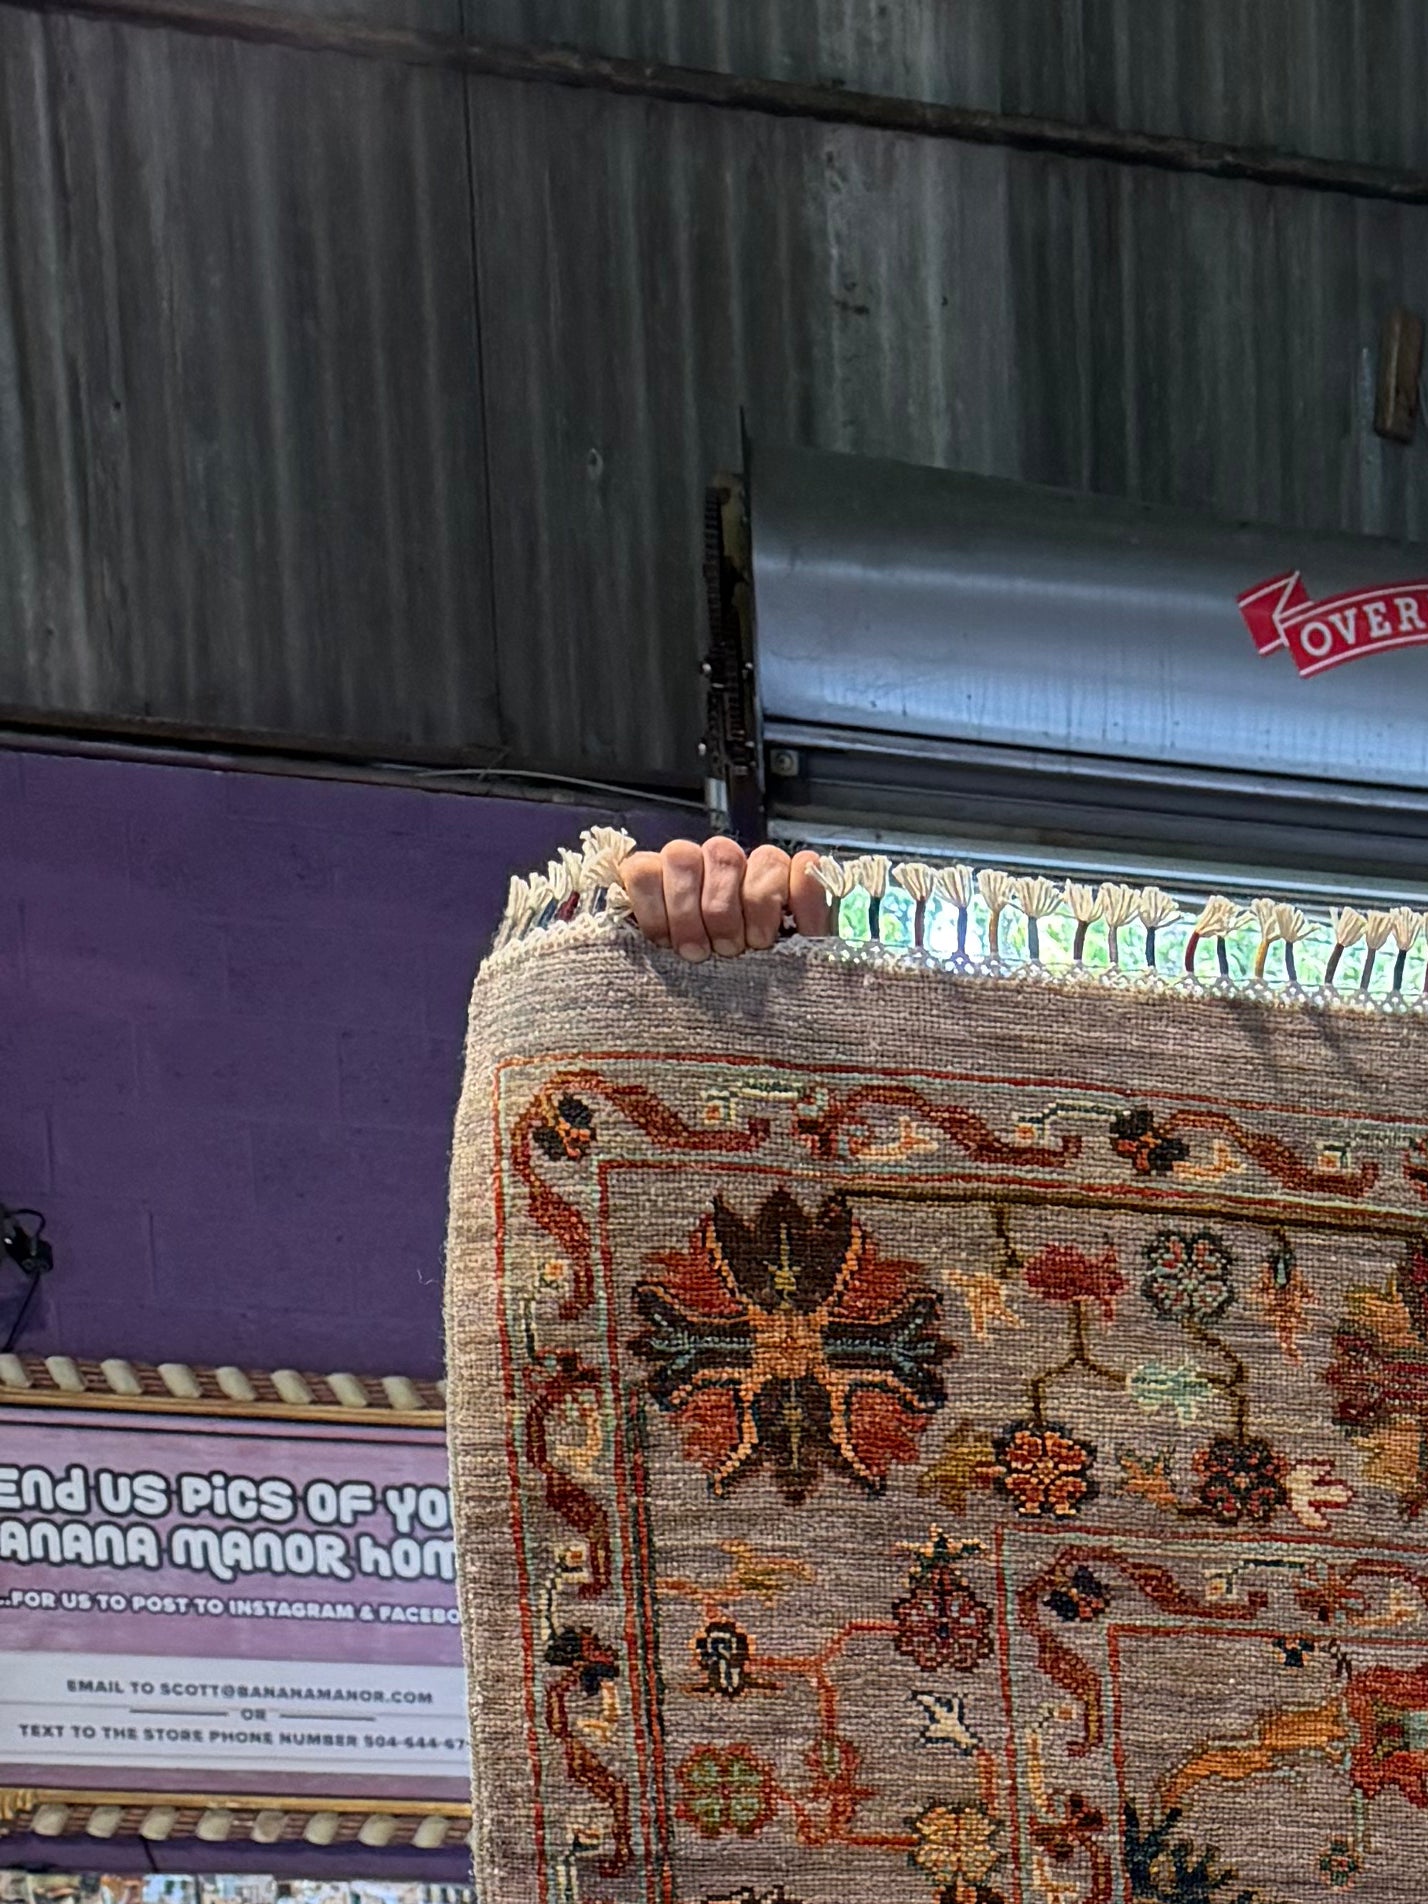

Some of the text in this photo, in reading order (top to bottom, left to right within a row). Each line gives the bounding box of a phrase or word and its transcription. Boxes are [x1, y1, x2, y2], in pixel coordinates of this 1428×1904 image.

[98, 1471, 170, 1517] US
[306, 1481, 374, 1525] OF
[385, 1486, 454, 1535] YO
[61, 1592, 93, 1611] US
[97, 1594, 127, 1612] TO
[132, 1595, 190, 1615] POST
[194, 1597, 225, 1616] TO
[229, 1600, 355, 1620] INSTAGRAM
[360, 1604, 375, 1621] &
[66, 1679, 434, 1704] EMAIL TO SCOTT@BANANAMANOR.COM
[240, 1708, 267, 1721] OR
[18, 1723, 65, 1738] TEXT
[70, 1725, 96, 1739] TO
[101, 1726, 137, 1740] THE
[143, 1728, 204, 1743] STORE
[208, 1730, 274, 1745] PHONE
[279, 1732, 359, 1748] NUMBER
